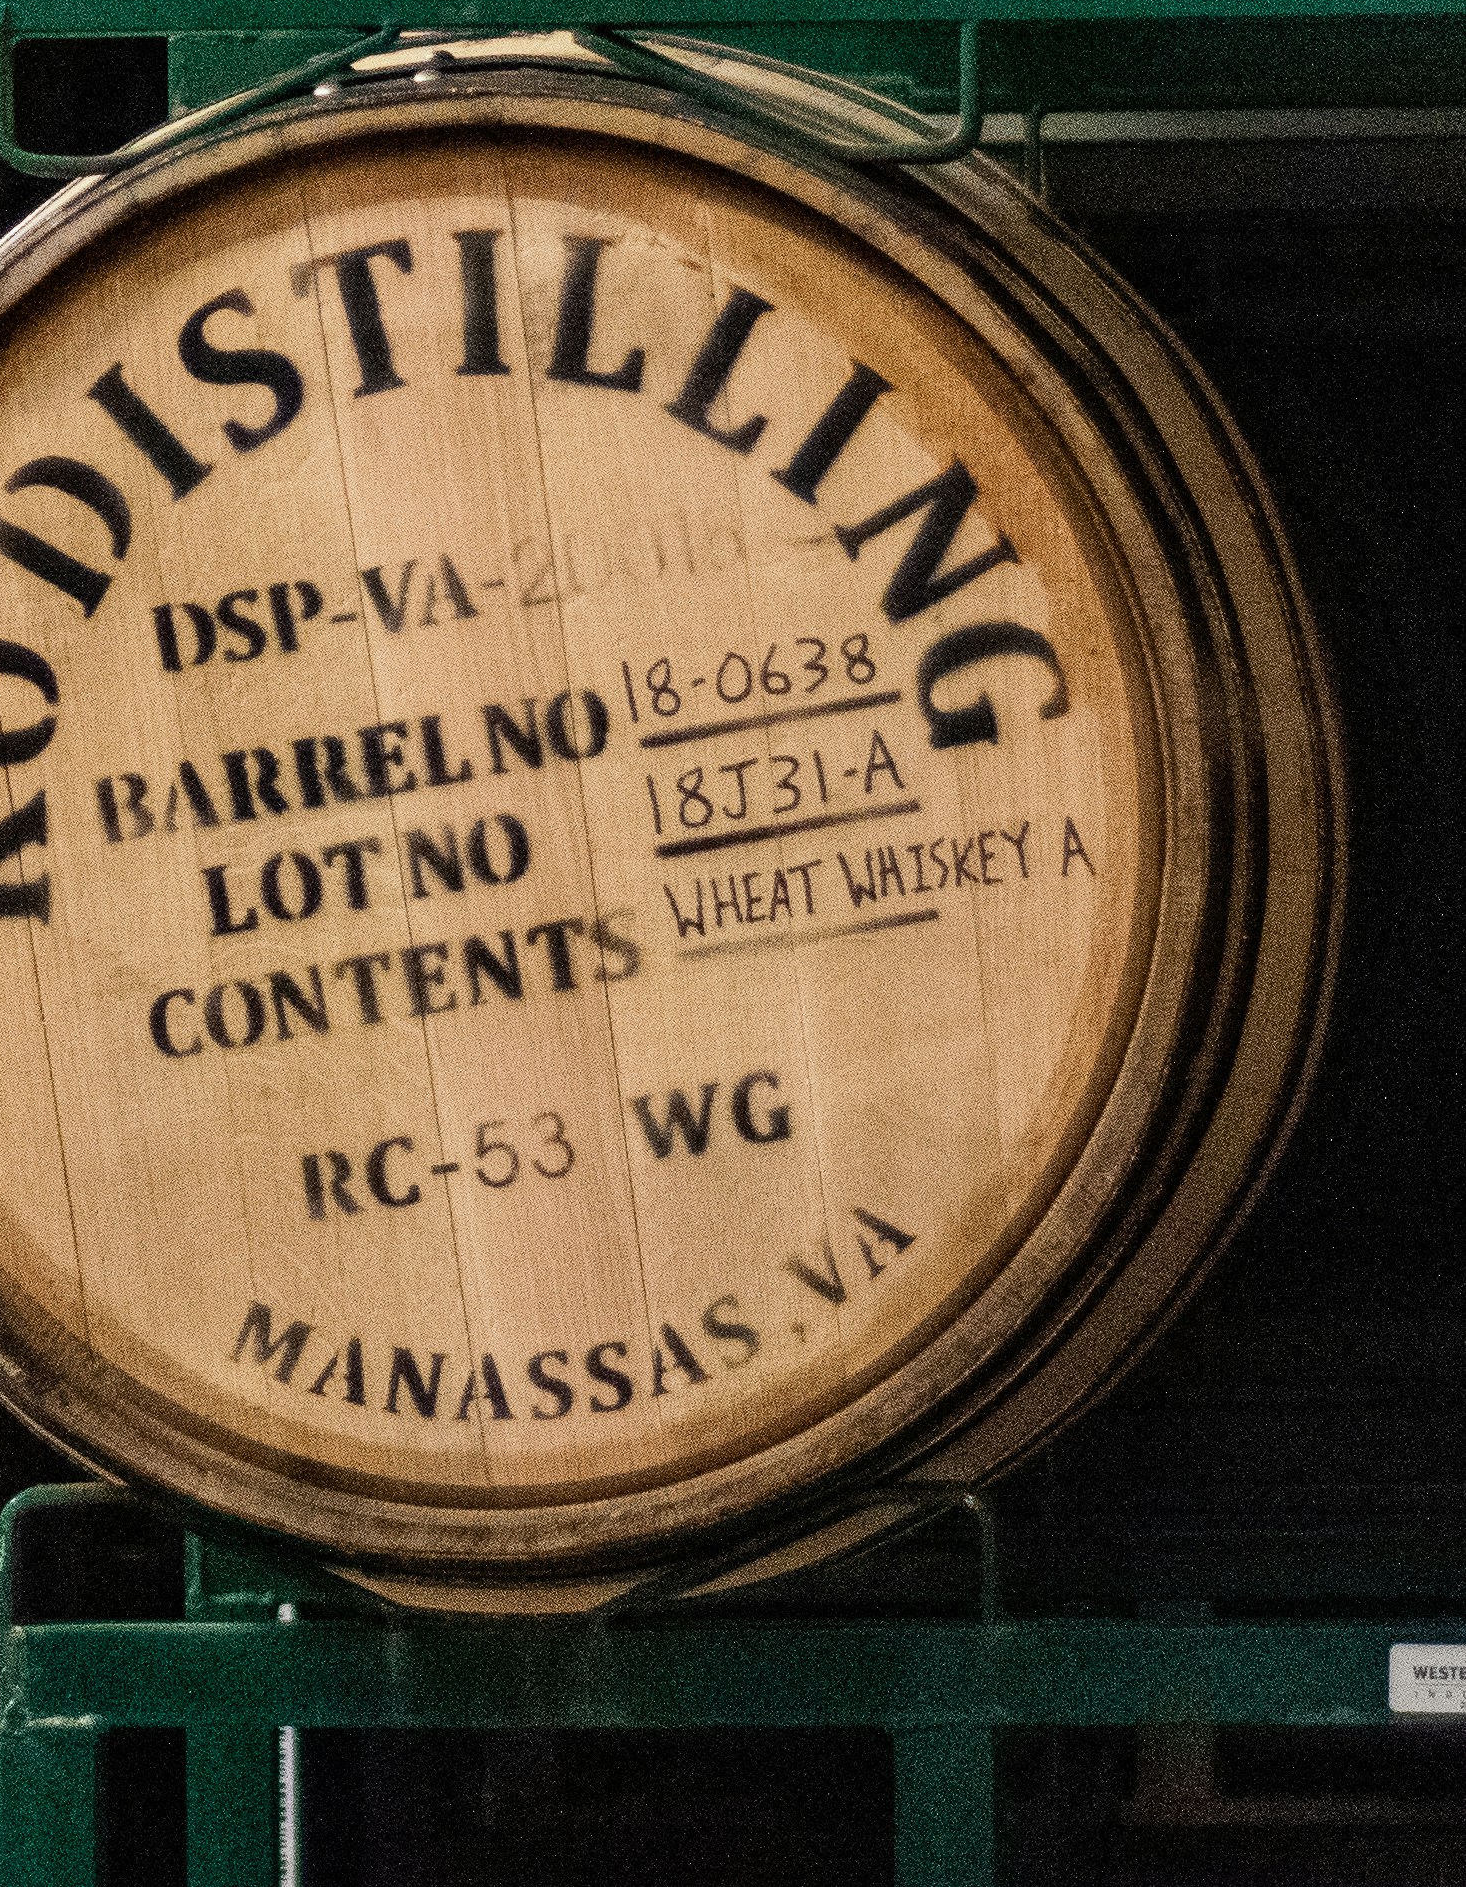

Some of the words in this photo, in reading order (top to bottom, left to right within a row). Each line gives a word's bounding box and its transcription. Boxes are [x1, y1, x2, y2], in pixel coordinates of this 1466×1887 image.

[623, 630, 879, 724] 18-0638
[93, 716, 476, 846] BARREL
[483, 688, 612, 775] NO
[646, 729, 908, 837] 18J31-A
[201, 833, 388, 939] LOT
[410, 813, 535, 902] NO
[664, 858, 822, 940] WHEAT
[834, 821, 1035, 907] WHISKEY
[1058, 816, 1096, 876] A
[147, 909, 644, 1059] CONTENTS
[301, 1112, 578, 1223] RC-53
[631, 1069, 792, 1164] WG
[778, 1206, 919, 1307] VA
